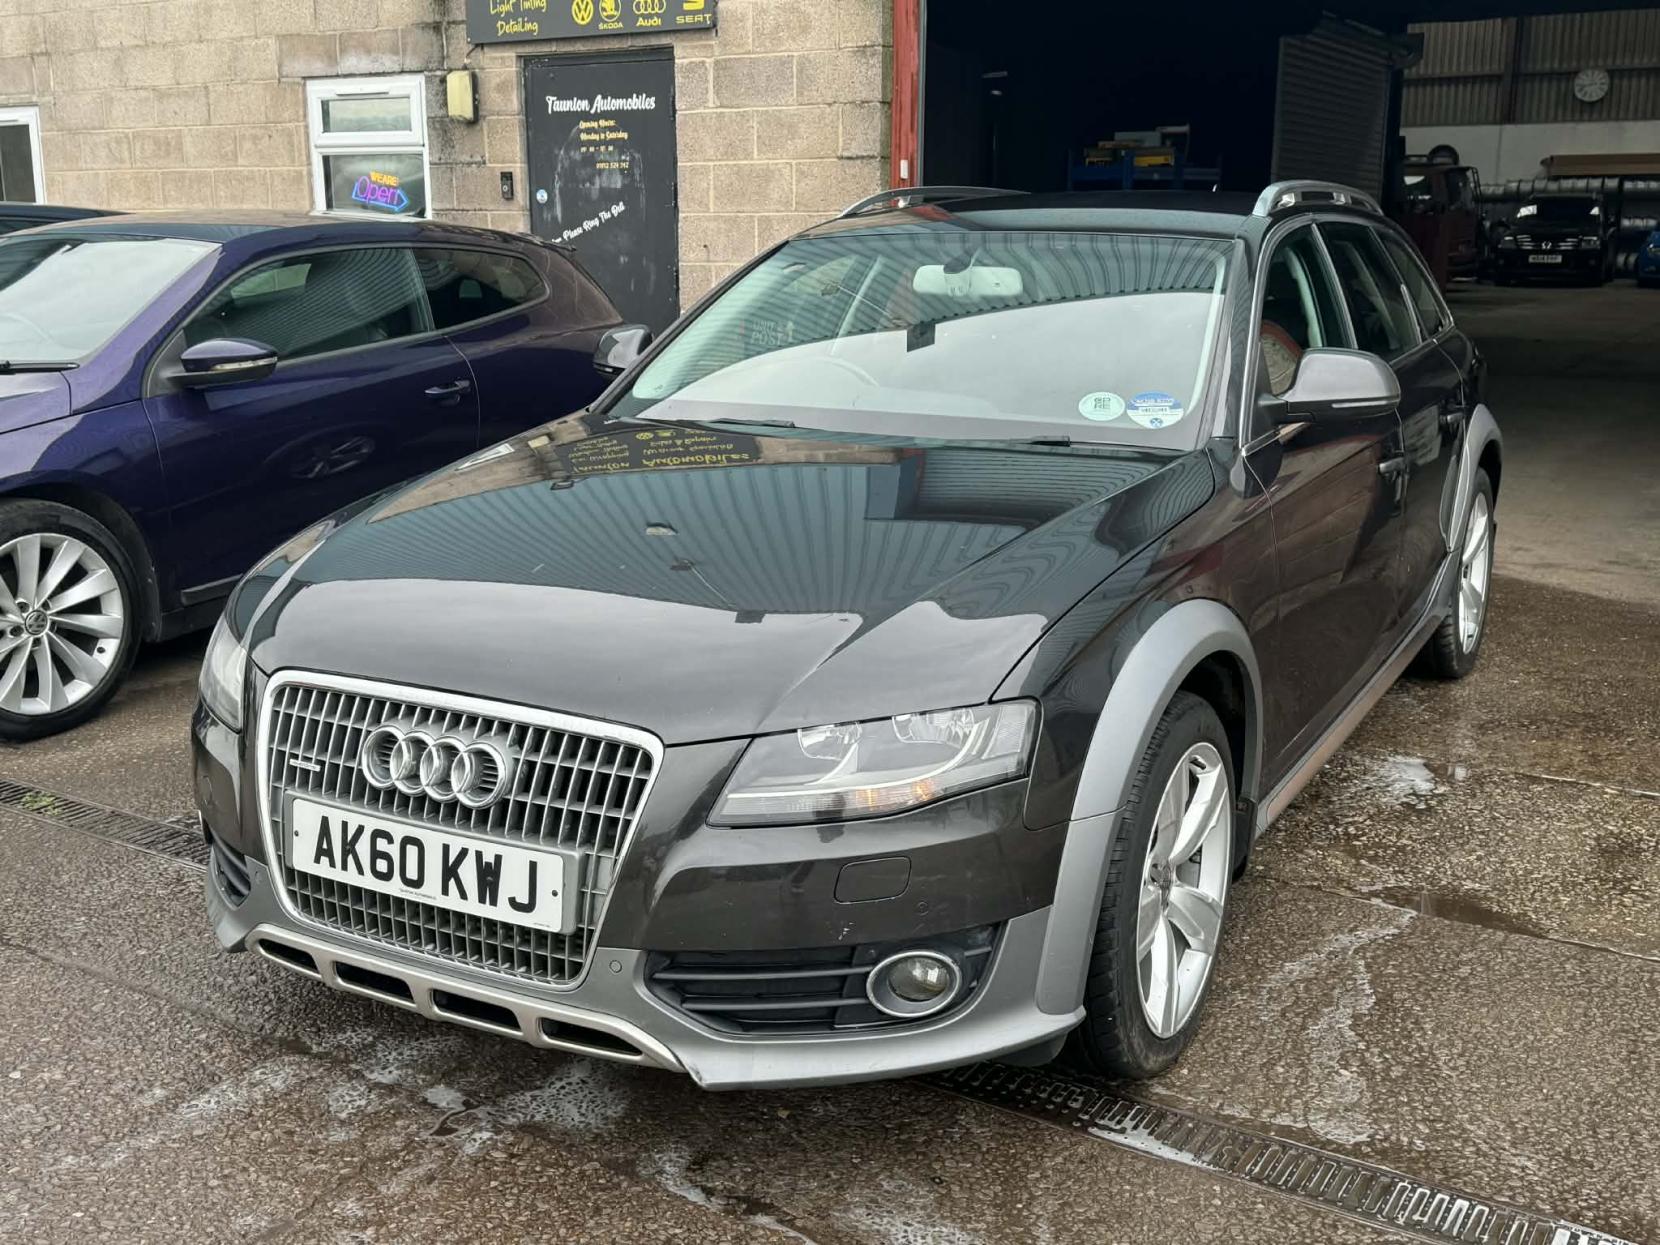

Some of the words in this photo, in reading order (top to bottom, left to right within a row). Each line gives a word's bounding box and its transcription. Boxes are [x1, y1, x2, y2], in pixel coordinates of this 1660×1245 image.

[636, 17, 662, 27] Audi
[675, 13, 712, 25] SEAT
[545, 95, 590, 115] Taunton
[590, 93, 656, 114] Automobiles
[357, 175, 398, 205] Open
[313, 815, 426, 890] AK60
[441, 842, 538, 914] KWJ
